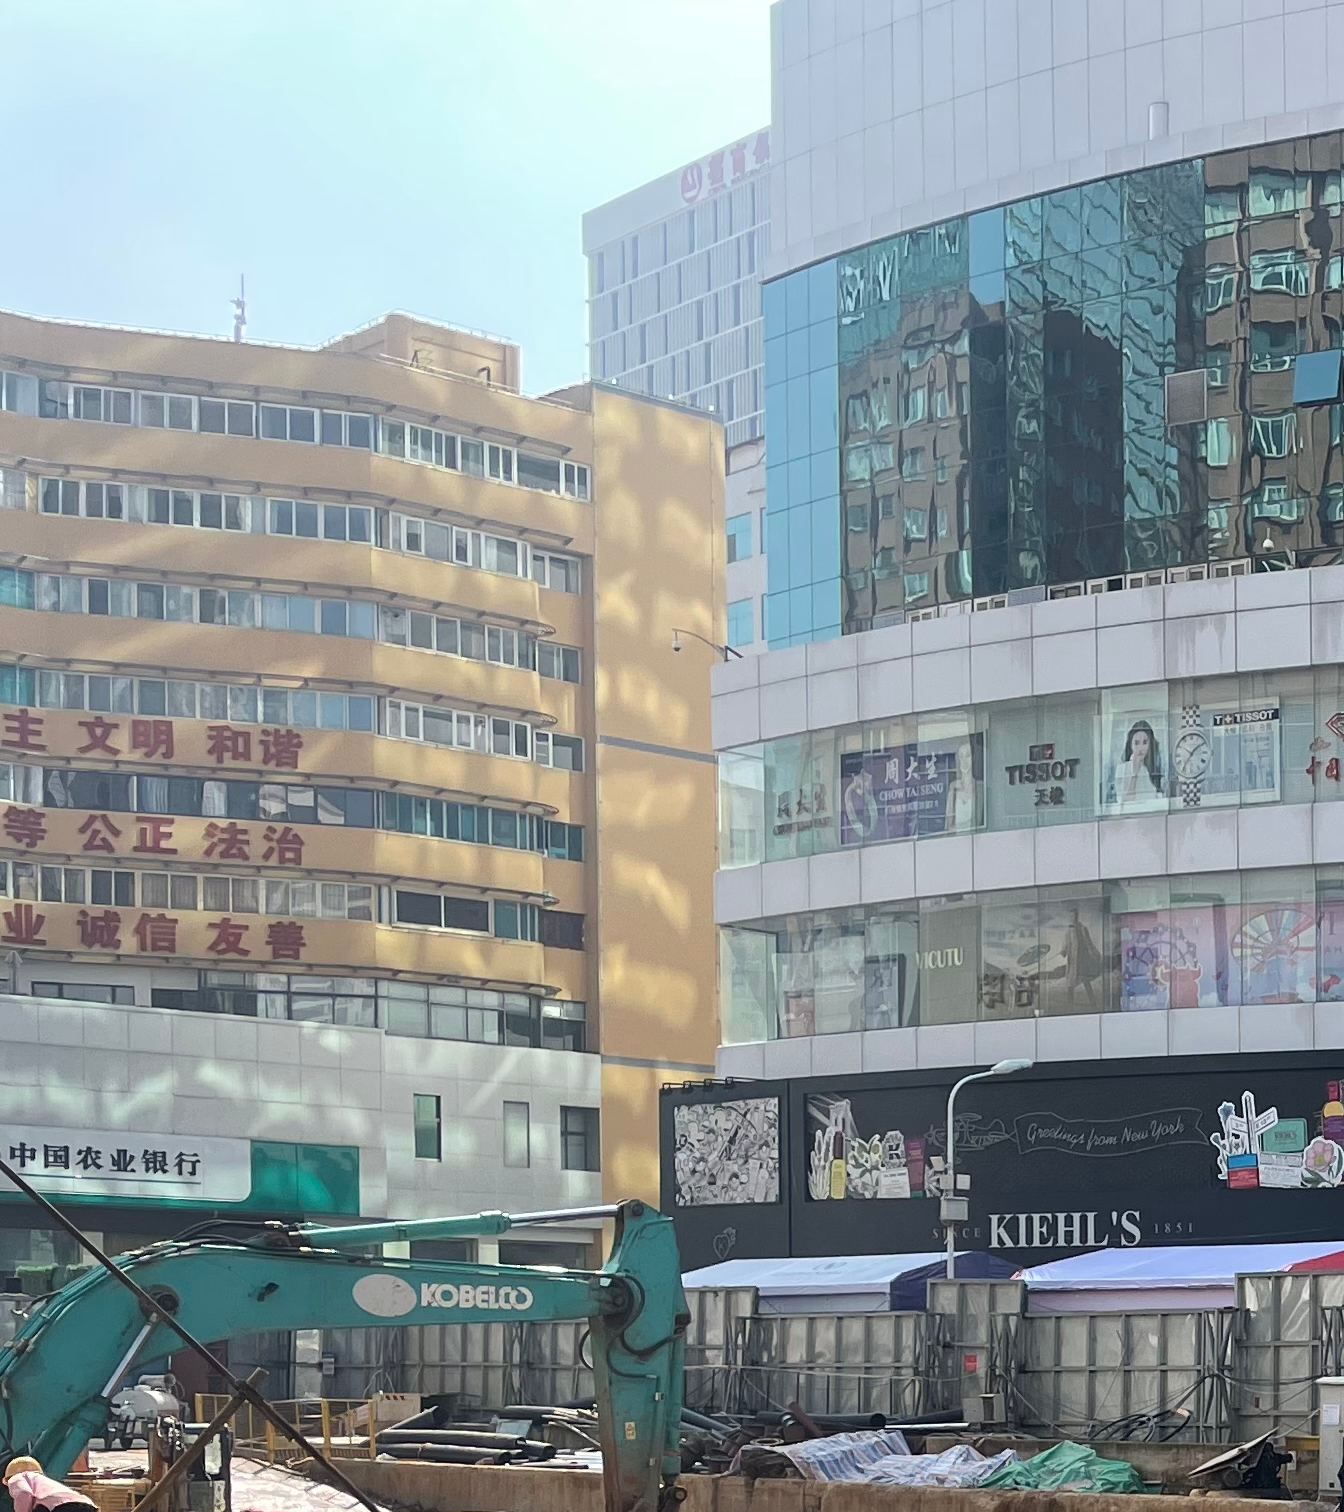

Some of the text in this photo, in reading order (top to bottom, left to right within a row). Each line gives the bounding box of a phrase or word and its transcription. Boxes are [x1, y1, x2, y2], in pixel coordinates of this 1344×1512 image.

[1234, 709, 1275, 723] TISSOT
[2, 708, 304, 770] 主 文明 和谐
[884, 752, 939, 785] 周大生
[1004, 758, 1080, 786] TISSOT
[3, 805, 306, 866] 等 公正 法治
[2, 904, 307, 960] 业 诚信 友善
[916, 946, 964, 970] VICUTU
[1026, 1115, 1185, 1150] Greetings from New York
[9, 1142, 202, 1176] 中国农业银行
[988, 1210, 1142, 1249] KIEHL'S
[1153, 1221, 1194, 1235] 1851
[420, 1282, 533, 1310] KOBELCO
